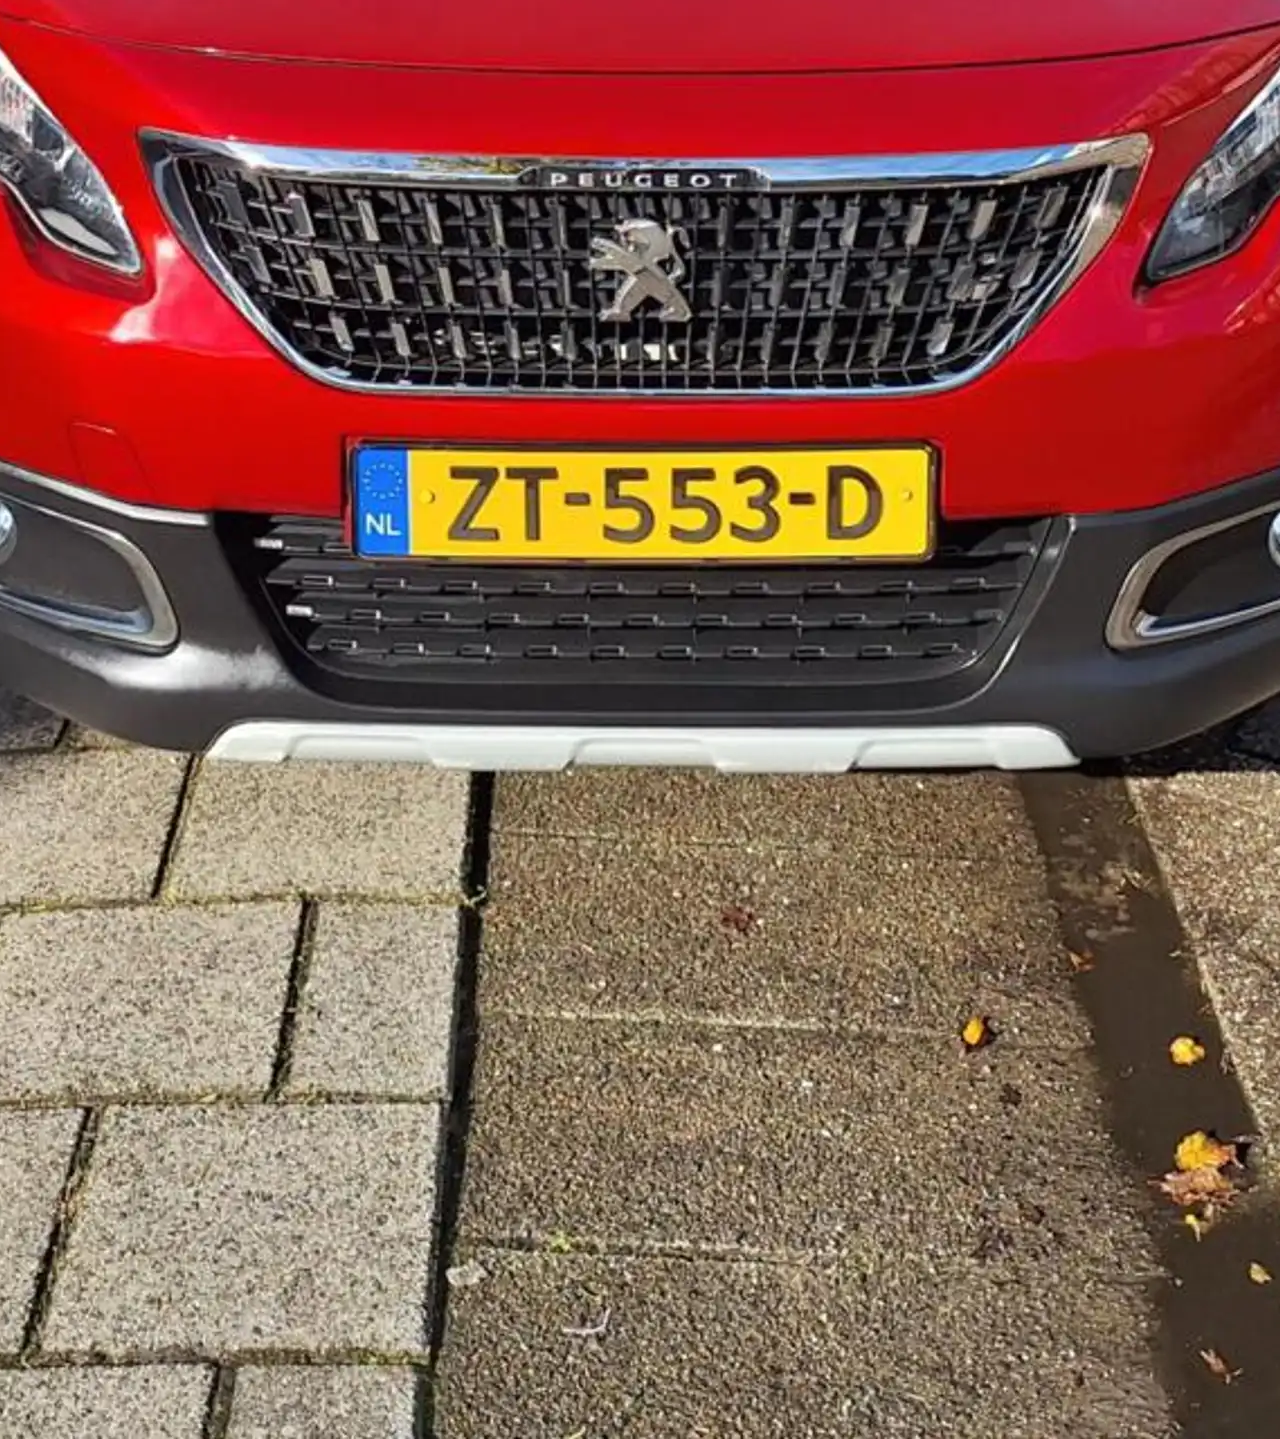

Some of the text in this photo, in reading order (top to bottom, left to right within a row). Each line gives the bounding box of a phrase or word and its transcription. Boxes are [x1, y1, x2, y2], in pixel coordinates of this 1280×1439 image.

[549, 172, 740, 190] PEUGEOT
[447, 464, 883, 544] ZT-553-D
[365, 512, 403, 537] NL
